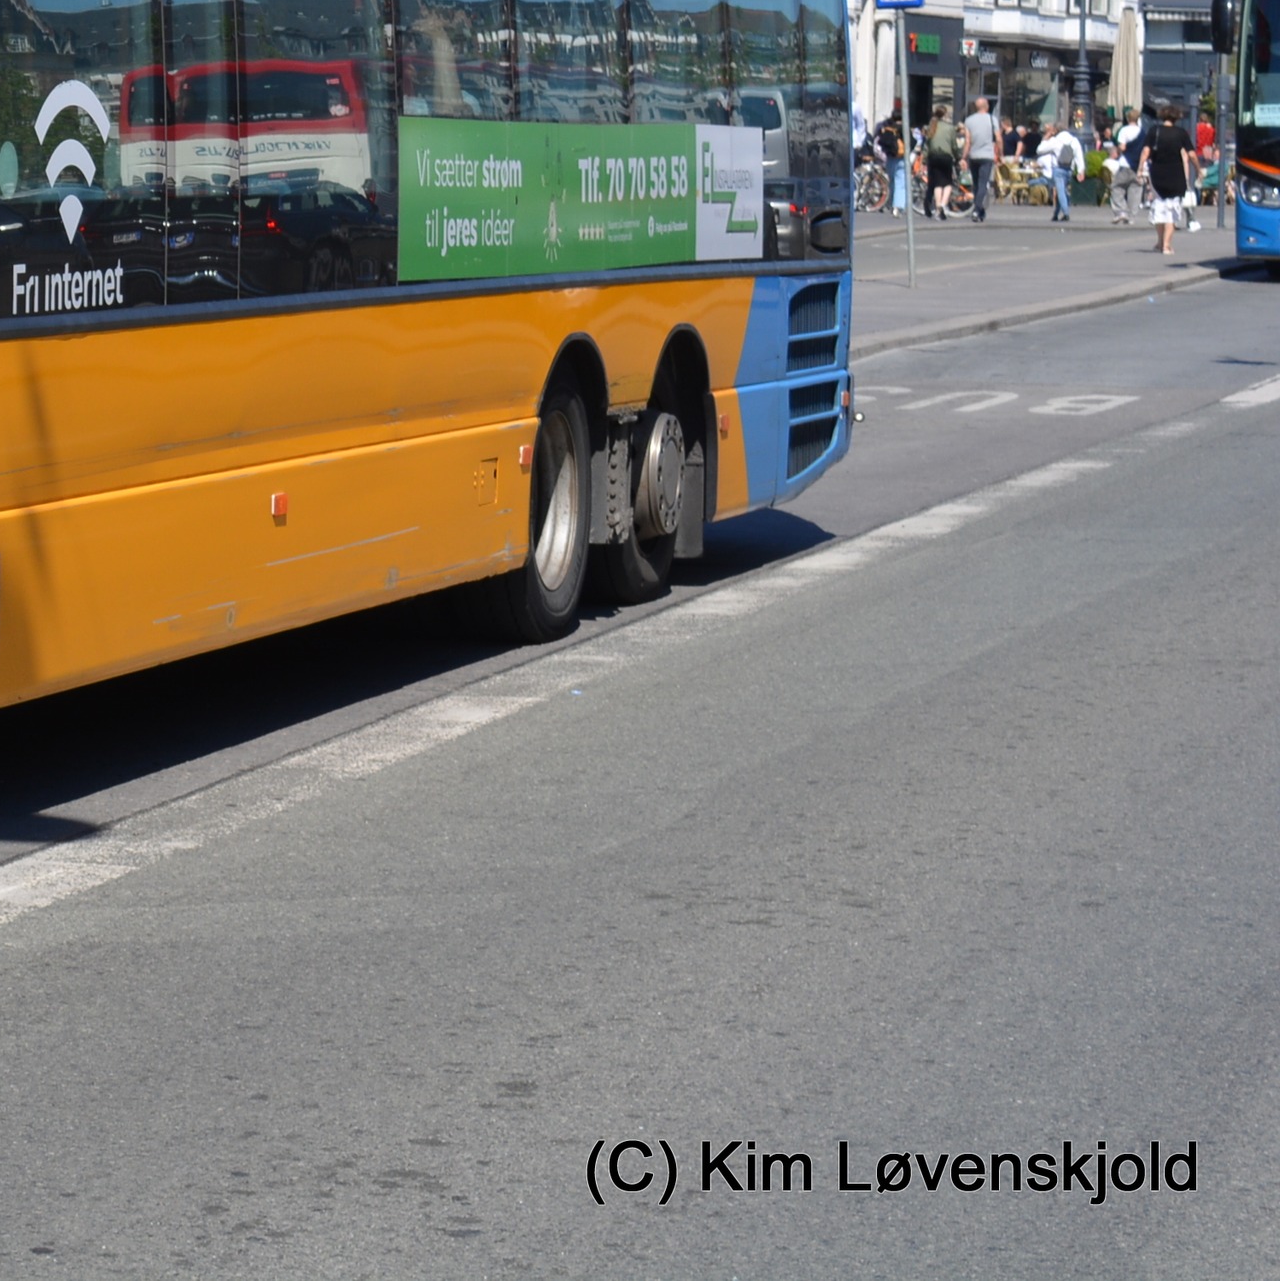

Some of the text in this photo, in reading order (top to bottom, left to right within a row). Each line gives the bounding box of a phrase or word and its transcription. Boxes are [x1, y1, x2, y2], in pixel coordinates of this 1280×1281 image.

[416, 148, 523, 191] Vi sætter strøm
[578, 155, 689, 204] Tlf. 70 70 58 58
[425, 206, 515, 257] til jeres idéer
[45, 258, 124, 311] internet
